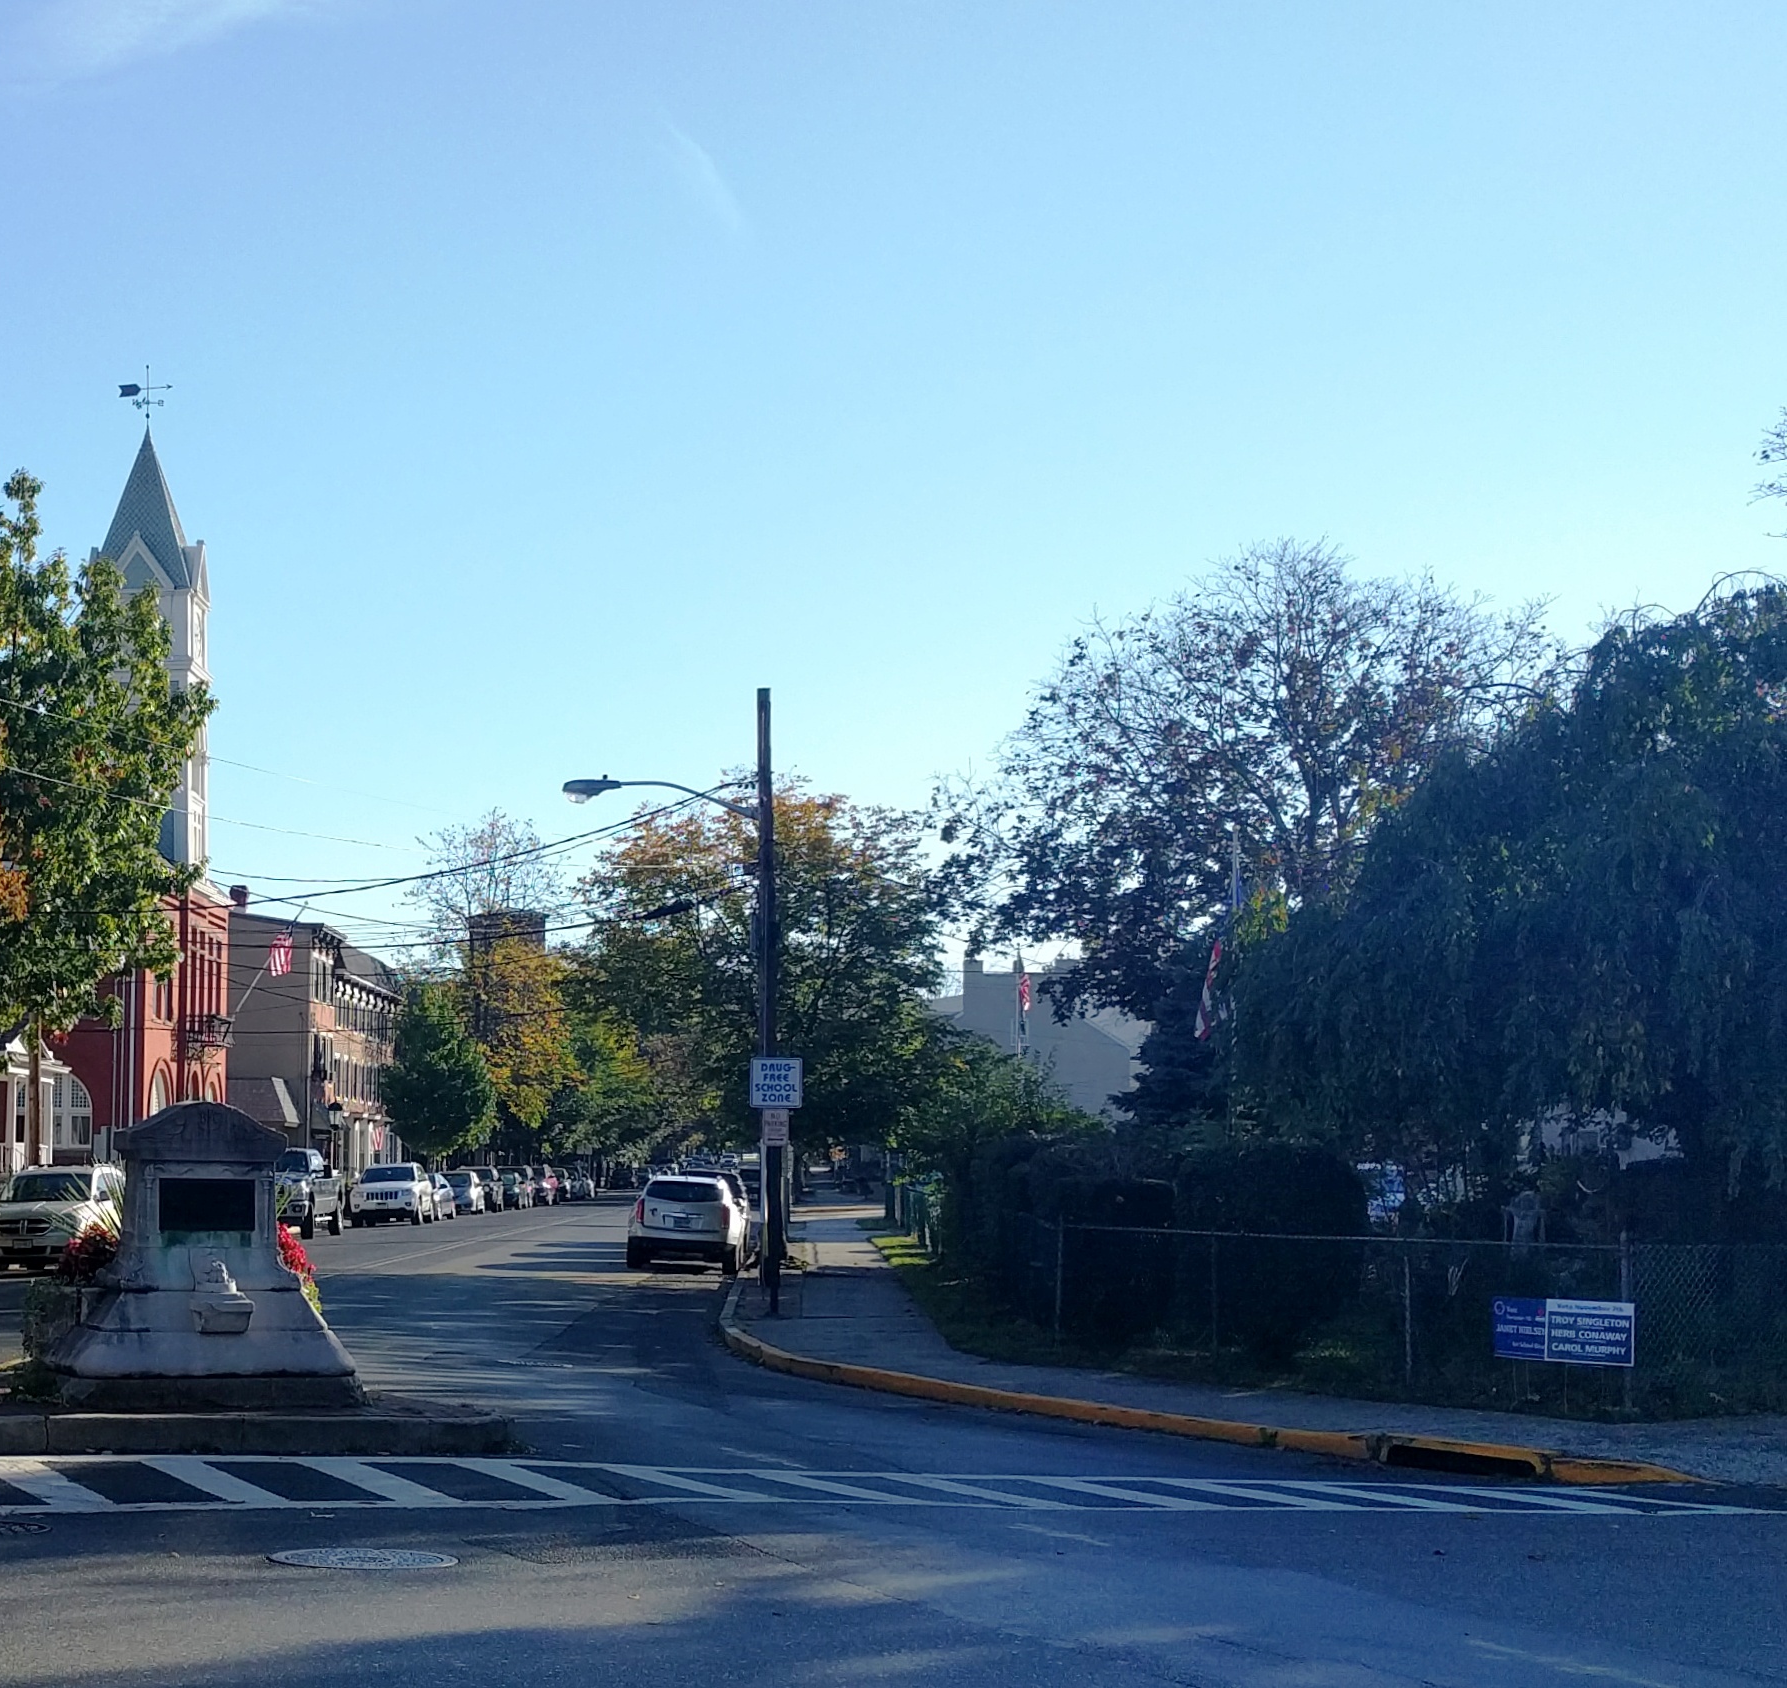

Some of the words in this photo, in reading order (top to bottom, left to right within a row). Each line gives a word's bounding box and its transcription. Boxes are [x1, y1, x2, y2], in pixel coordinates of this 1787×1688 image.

[763, 1073, 789, 1082] FREE
[755, 1083, 798, 1092] SCHOOL
[761, 1093, 791, 1102] ZONE
[1550, 1315, 1575, 1325] TROY
[1576, 1316, 1630, 1328] SINGLETON
[1550, 1328, 1576, 1338] HERB
[1578, 1331, 1628, 1341] CONAWAY
[1551, 1342, 1583, 1353] CAROL
[1585, 1345, 1627, 1356] MURPHY
